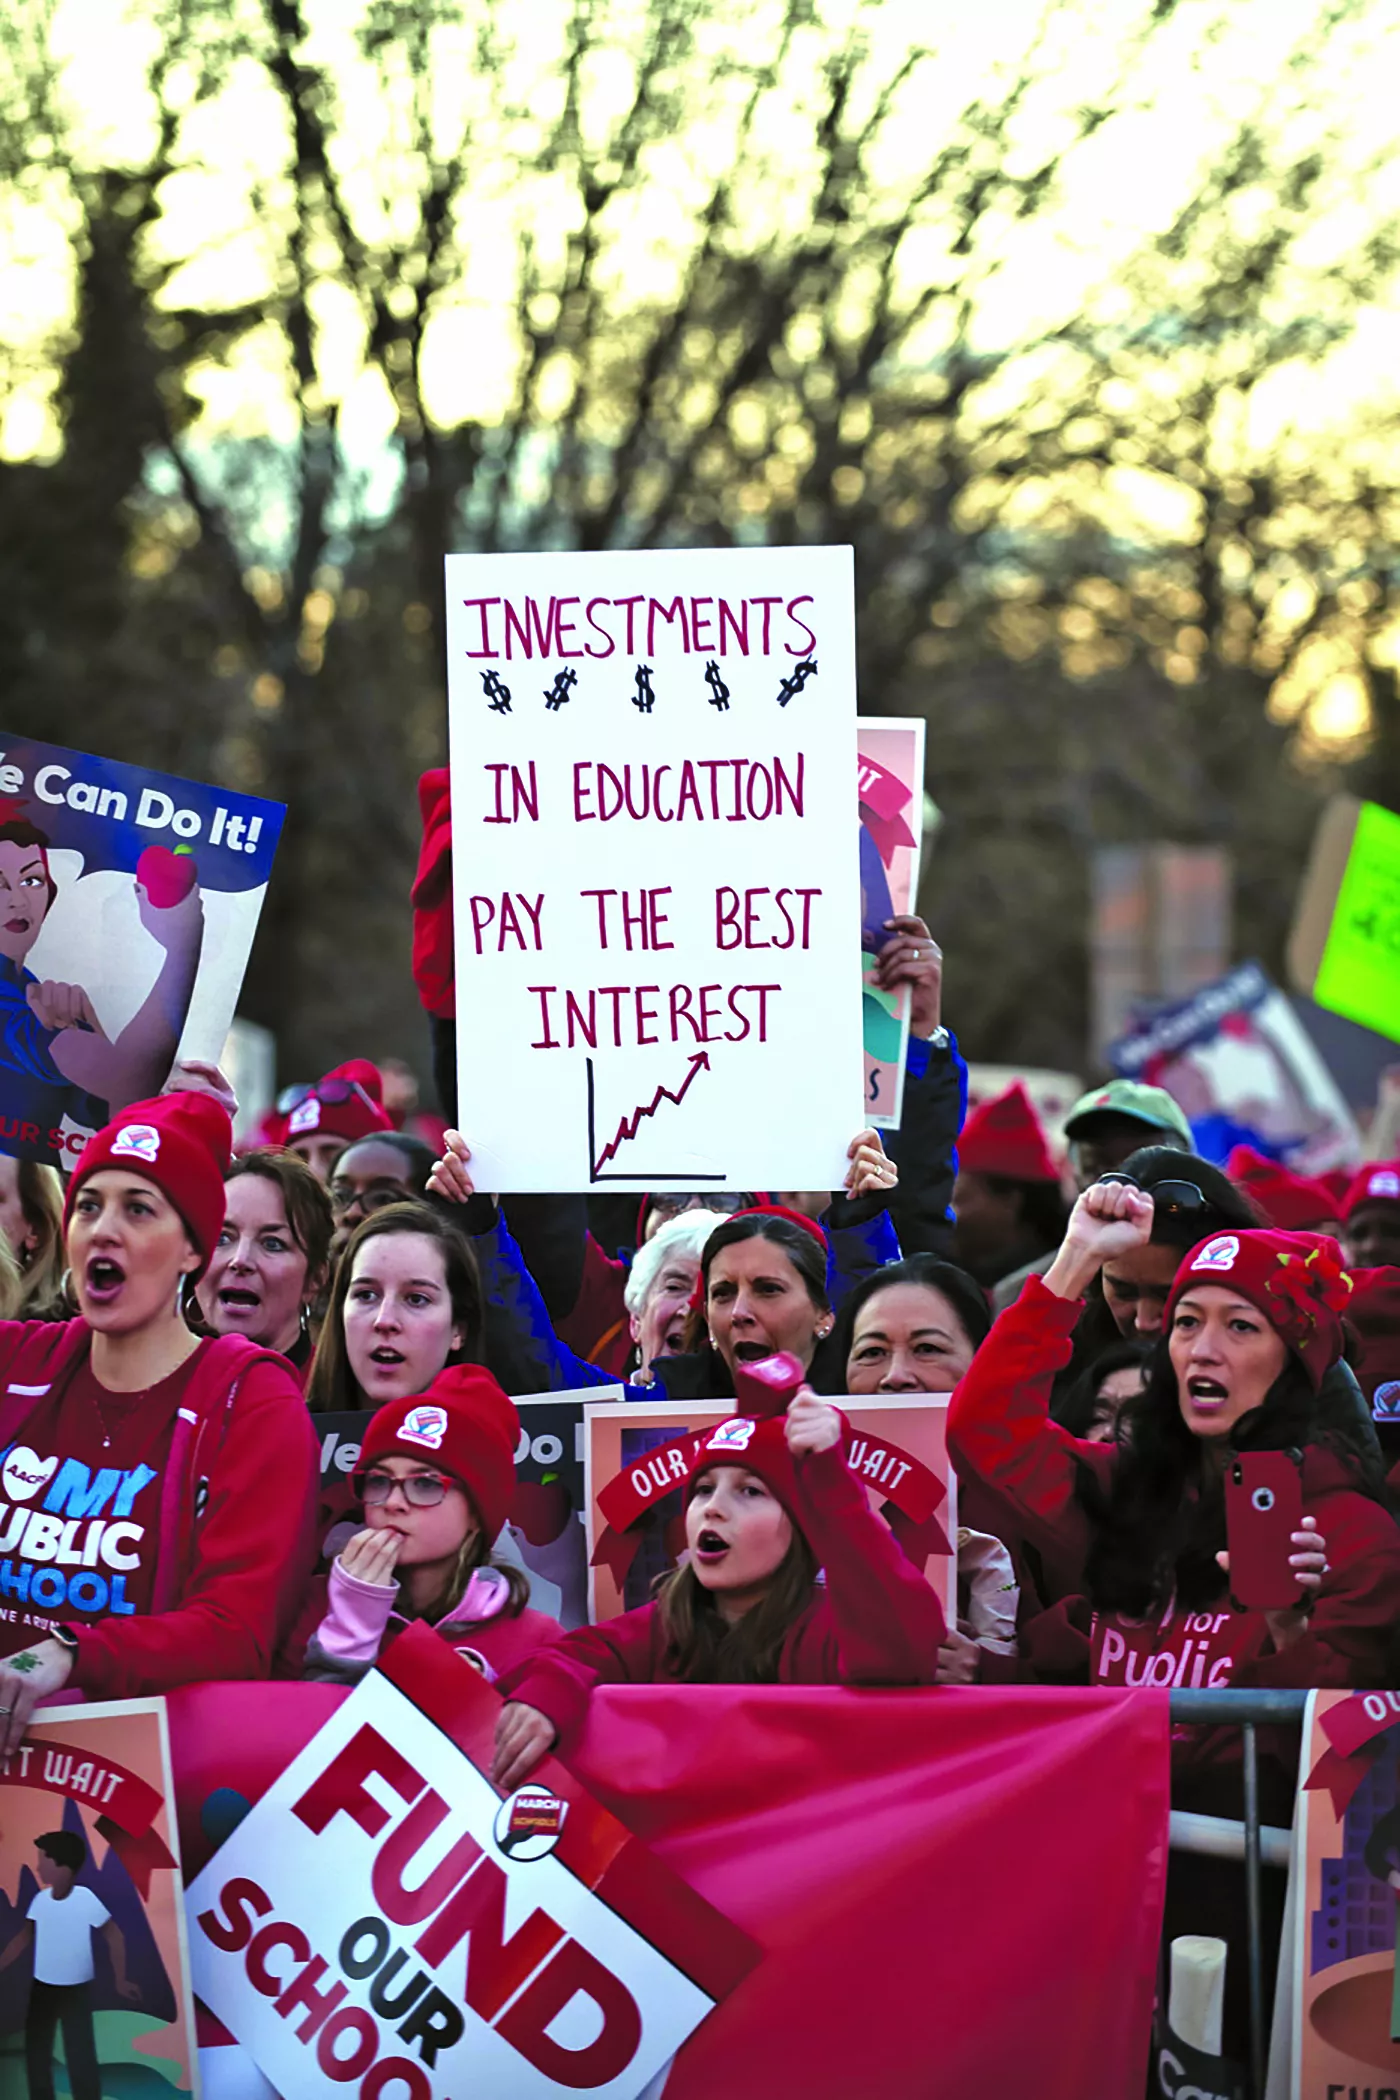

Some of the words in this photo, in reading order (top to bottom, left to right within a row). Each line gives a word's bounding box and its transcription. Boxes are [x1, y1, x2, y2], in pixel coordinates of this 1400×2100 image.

[463, 595, 816, 660] INVESTMENTS
[479, 669, 512, 715] $
[543, 665, 578, 711] $
[631, 664, 655, 713] $
[705, 660, 730, 712] $
[777, 654, 818, 708] $
[0, 753, 24, 793] e
[34, 765, 128, 821] Can
[135, 788, 201, 838] Do
[208, 807, 263, 853] It!
[483, 760, 539, 823] IN
[574, 752, 804, 822] EDUCATION
[470, 892, 545, 954] PAY
[580, 886, 674, 951] THE
[716, 886, 822, 951] BEST
[527, 984, 782, 1048] INTEREST
[43, 1457, 158, 1519] MY
[631, 1449, 688, 1497] OUR
[44, 1751, 125, 1803] WAIT
[291, 1722, 642, 2089] FUND
[339, 1916, 465, 2070] OUR
